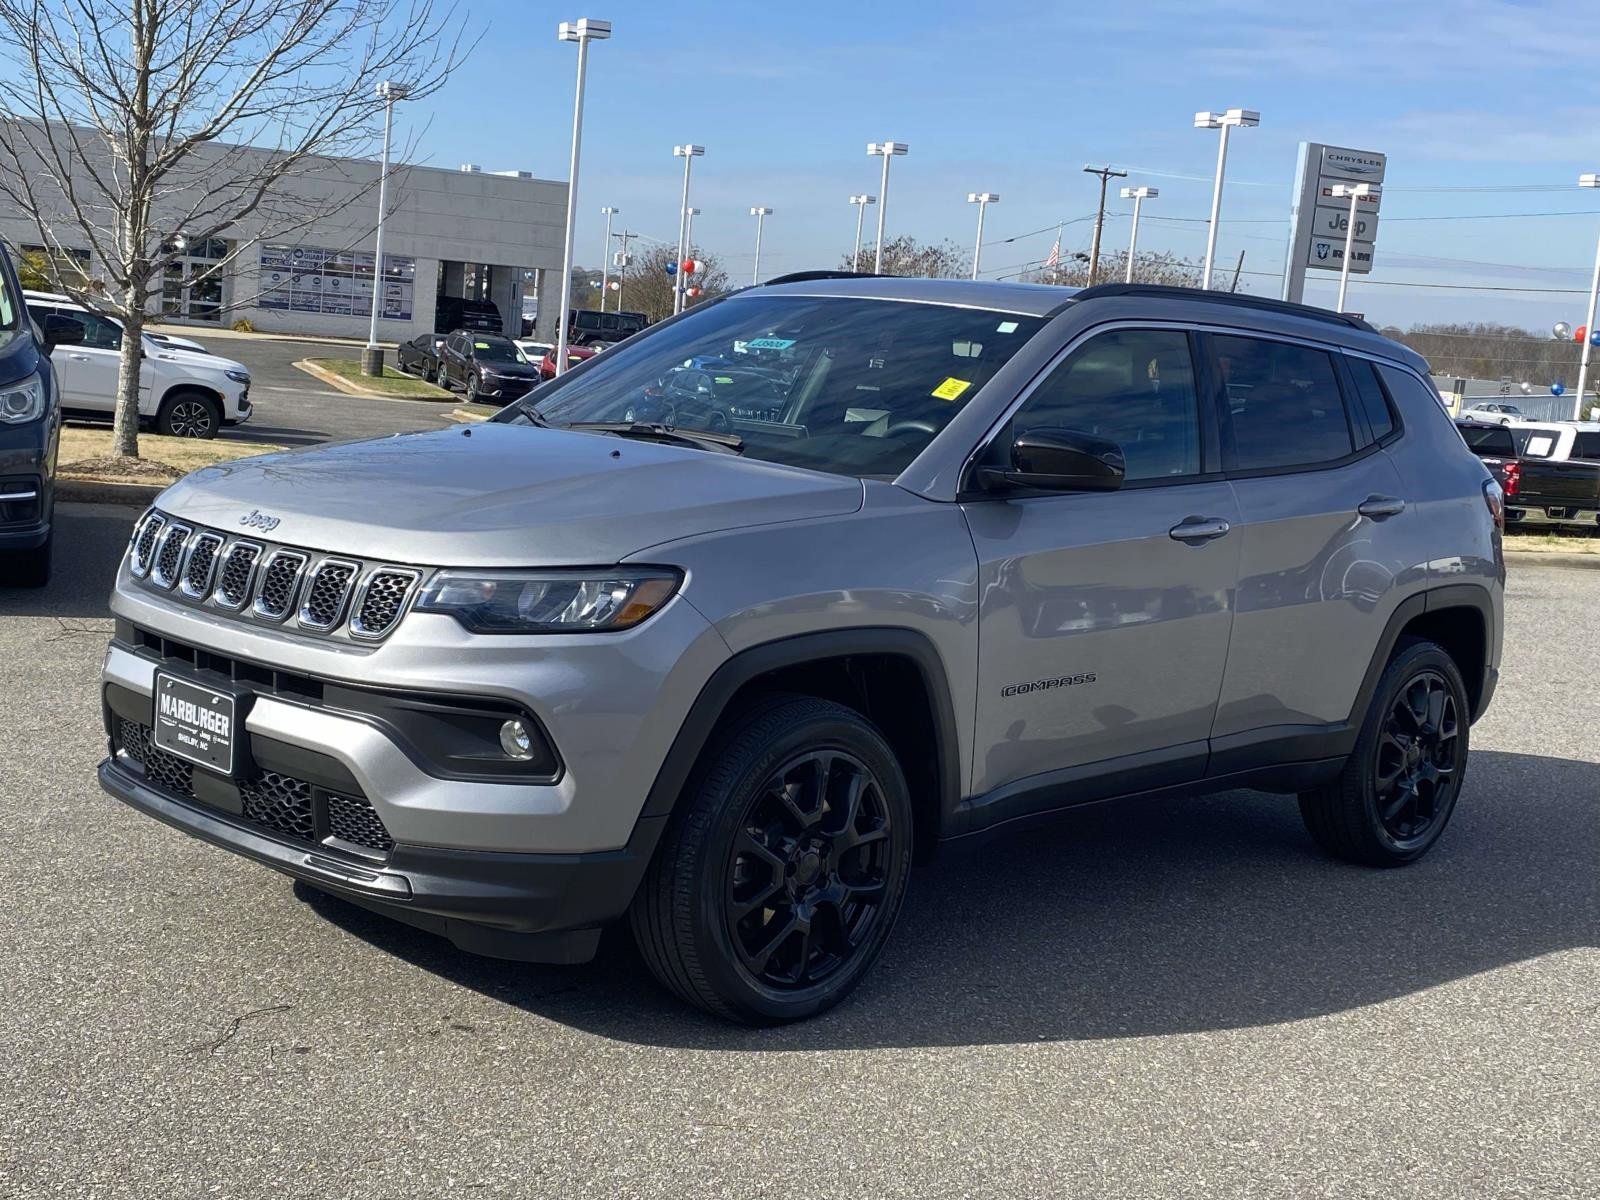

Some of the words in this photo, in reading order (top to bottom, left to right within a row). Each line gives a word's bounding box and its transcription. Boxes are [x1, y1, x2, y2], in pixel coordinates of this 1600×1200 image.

[1328, 154, 1382, 167] CHRYSLER
[1323, 188, 1377, 202] DGE
[1328, 213, 1366, 237] Jep
[239, 509, 281, 533] Jeep
[1001, 671, 1097, 698] COMPASS
[160, 693, 229, 736] MARBURGER
[199, 741, 209, 751] NC
